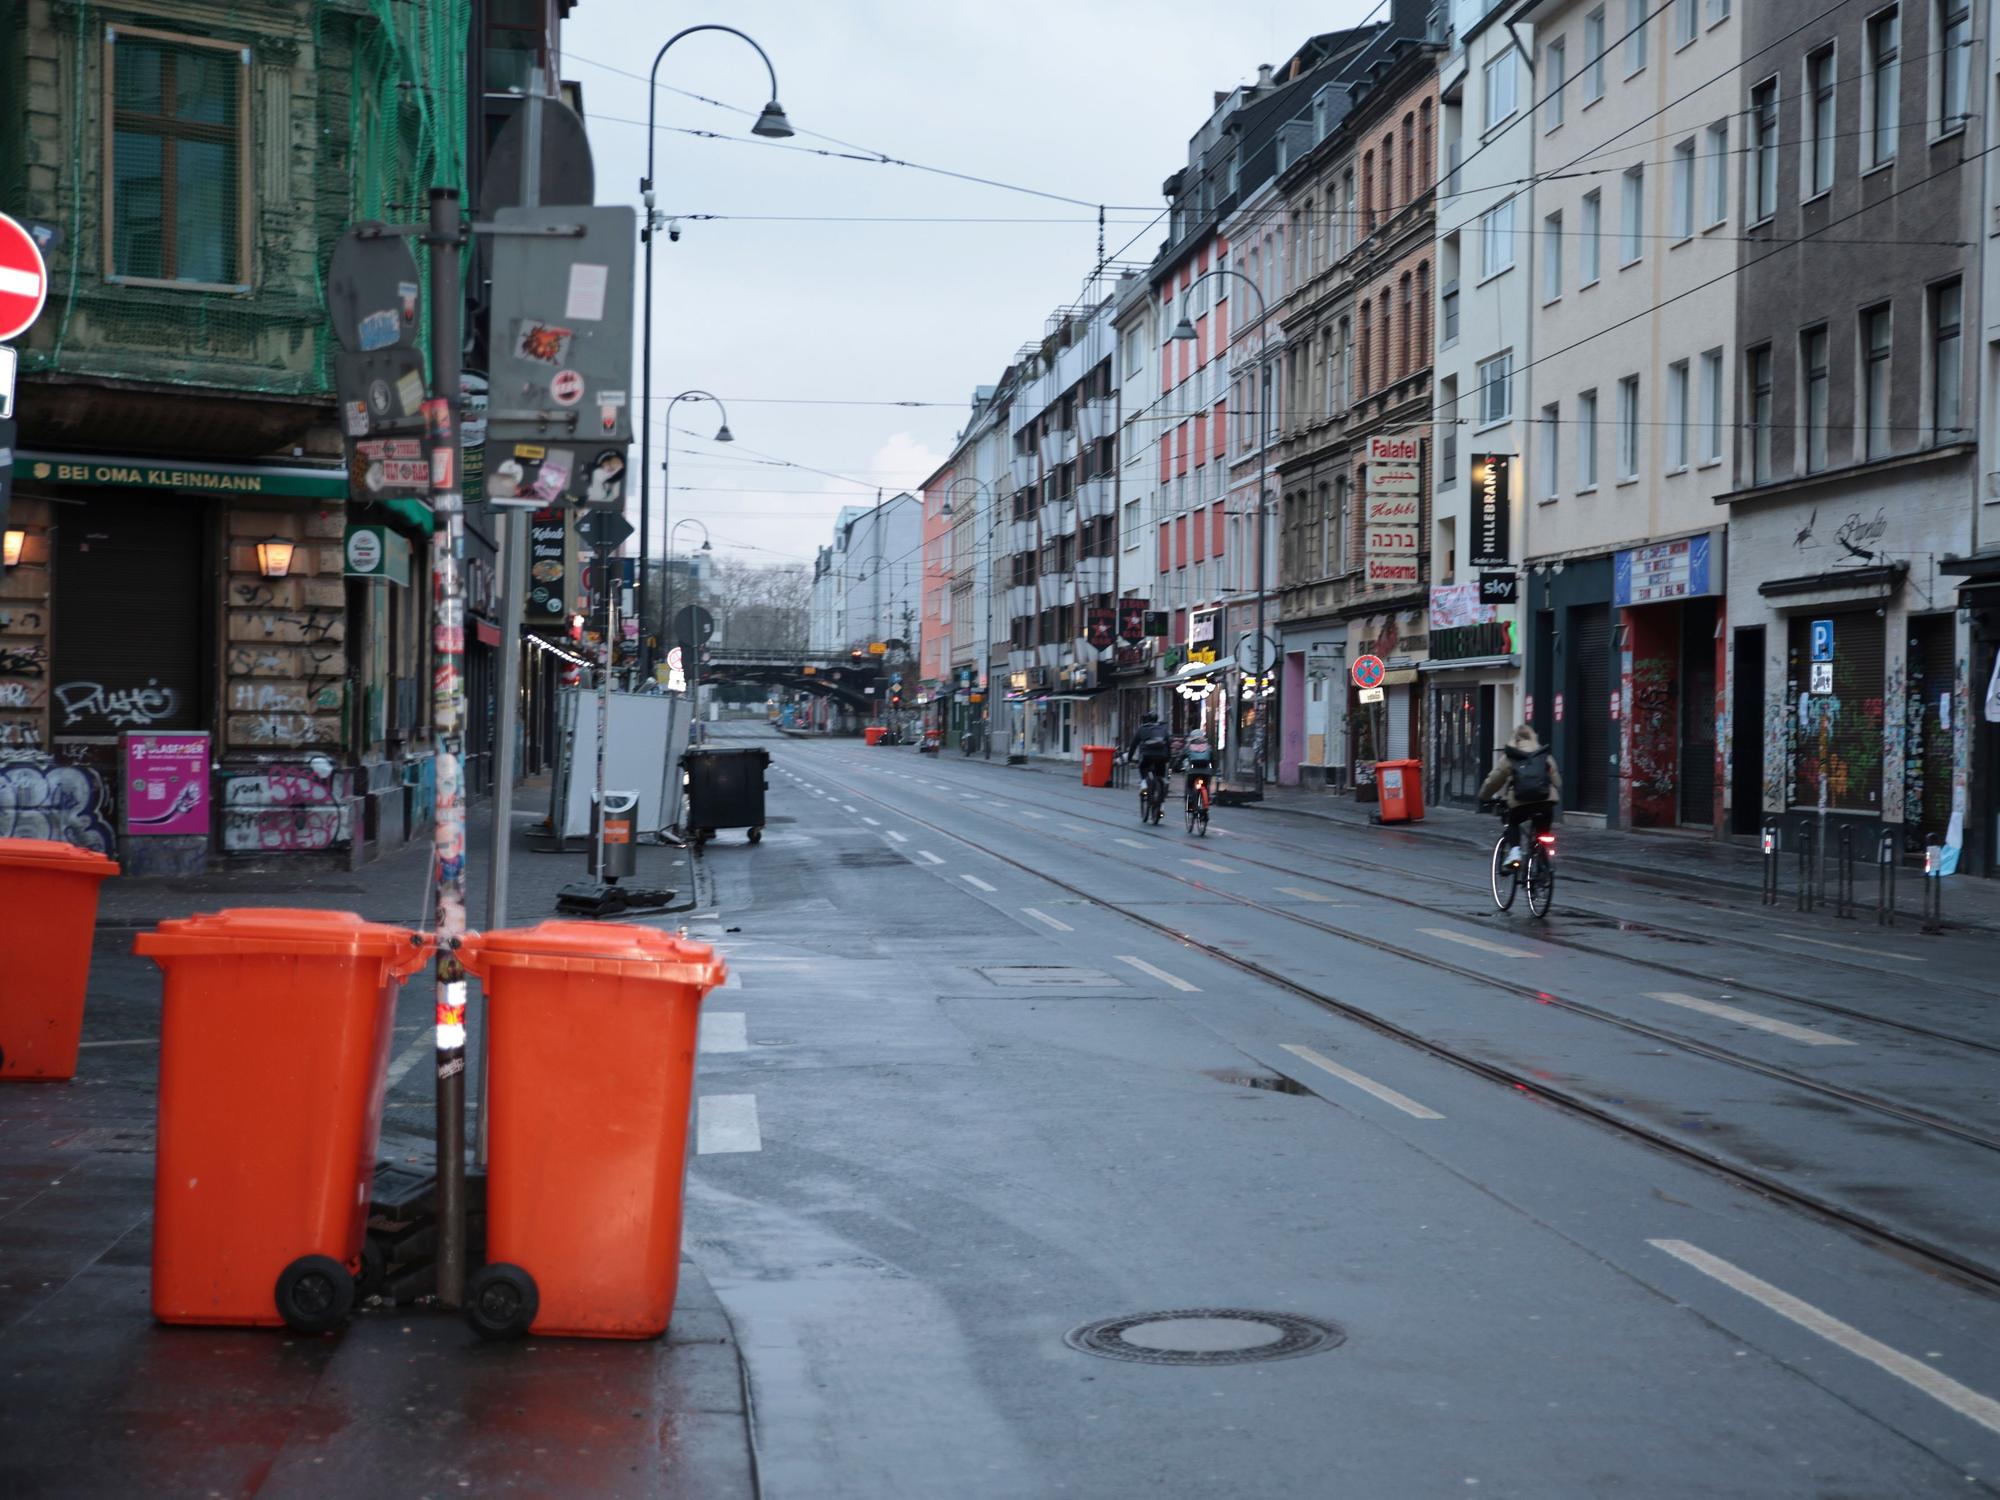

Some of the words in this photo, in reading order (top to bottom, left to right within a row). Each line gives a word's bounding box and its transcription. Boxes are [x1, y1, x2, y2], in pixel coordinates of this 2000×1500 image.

[1372, 440, 1416, 459] Falafel
[58, 465, 88, 480] BEI
[95, 467, 142, 483] OMA
[148, 470, 262, 491] KLEINMANN
[1370, 502, 1416, 518] Habibi
[1372, 534, 1415, 548] ברכה
[1369, 561, 1416, 580] Schawarma
[1483, 579, 1514, 597] sky
[1814, 626, 1827, 657] P
